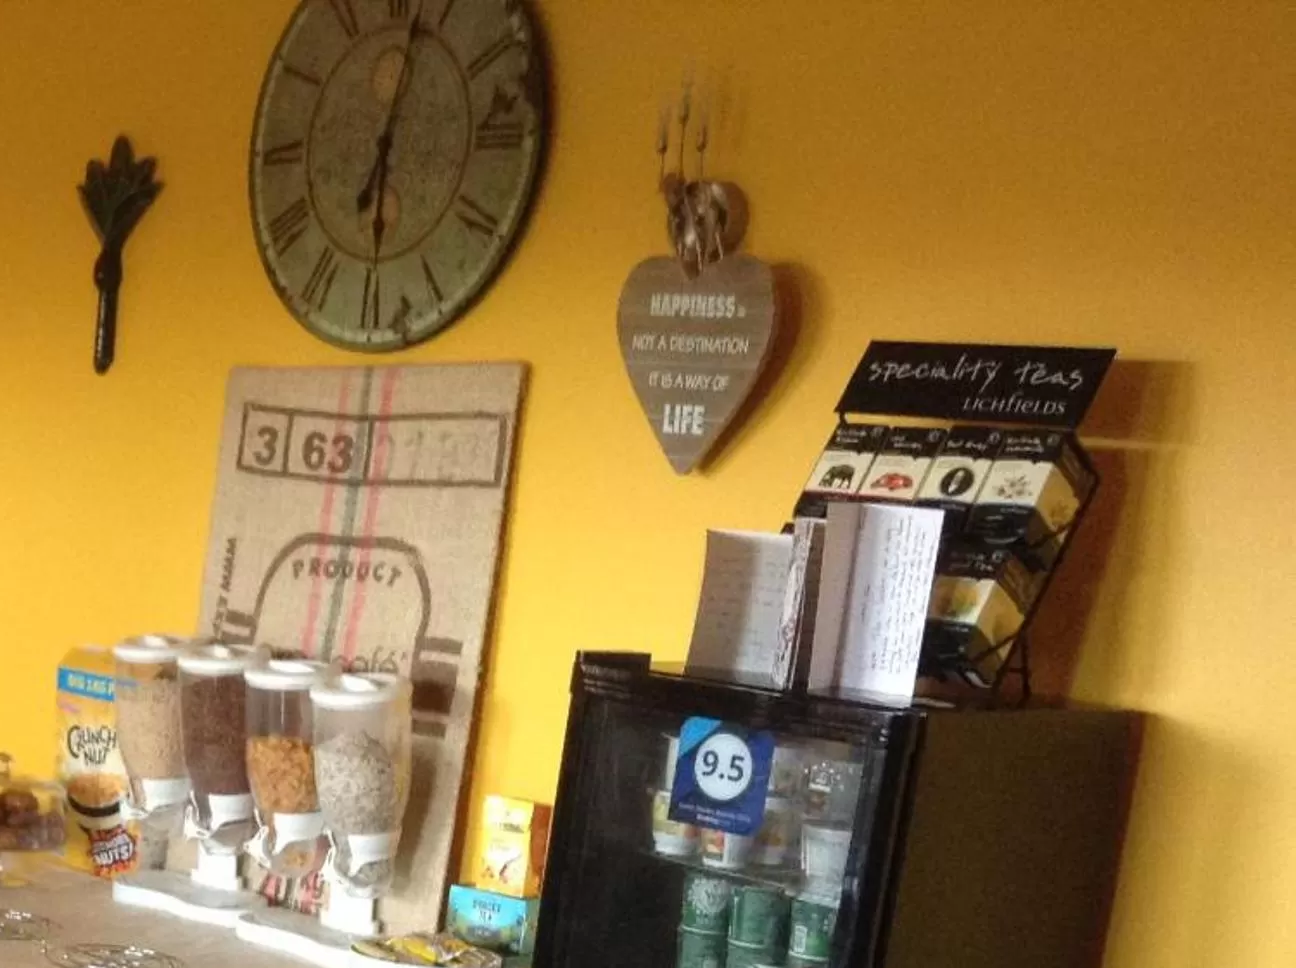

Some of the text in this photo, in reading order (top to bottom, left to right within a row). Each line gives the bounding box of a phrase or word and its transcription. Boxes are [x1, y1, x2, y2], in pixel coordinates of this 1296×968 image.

[650, 293, 736, 318] HAPPINESS
[632, 334, 749, 354] NOT A DESTINATION
[649, 371, 730, 391] IT IS A WAY OF
[869, 352, 1083, 393] speciality teas
[662, 404, 706, 434] LIFE
[254, 426, 279, 466] 3
[302, 431, 354, 473] 63
[292, 559, 403, 588] PRODUCT
[701, 749, 746, 783] 9.5
